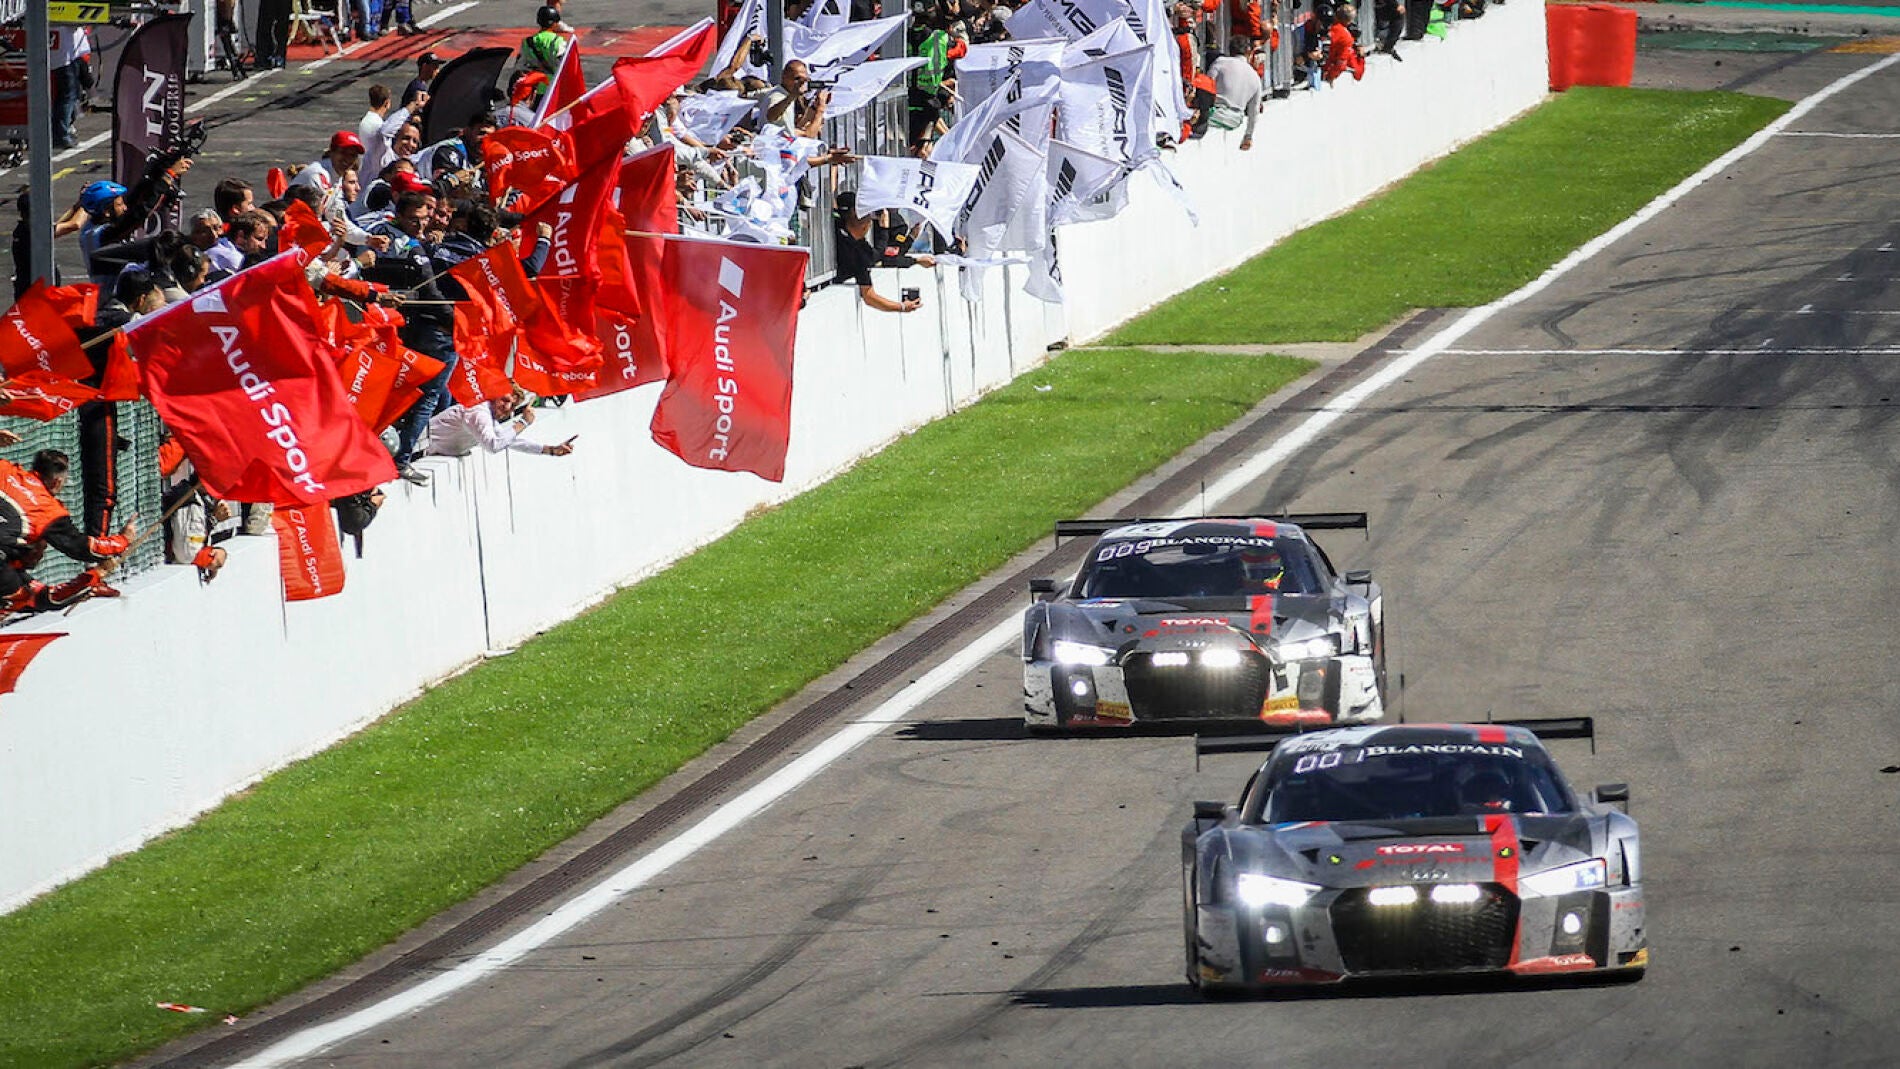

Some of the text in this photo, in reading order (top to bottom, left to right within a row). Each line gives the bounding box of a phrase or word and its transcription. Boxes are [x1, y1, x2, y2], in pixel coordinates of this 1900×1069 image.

[77, 5, 104, 18] 77
[515, 148, 549, 161] Sport
[554, 212, 579, 276] Audi
[478, 257, 500, 287] Audi
[12, 319, 43, 349] Audi
[351, 365, 369, 394] Audi
[465, 369, 484, 400] Sport
[709, 299, 738, 461] Audi Sport
[209, 325, 326, 493] Audi Sport
[1149, 536, 1274, 548] BLANCPAIN
[296, 526, 323, 594] Audi Sport
[1366, 744, 1523, 758] BLANCPAIN
[1378, 844, 1462, 854] TOTAL
